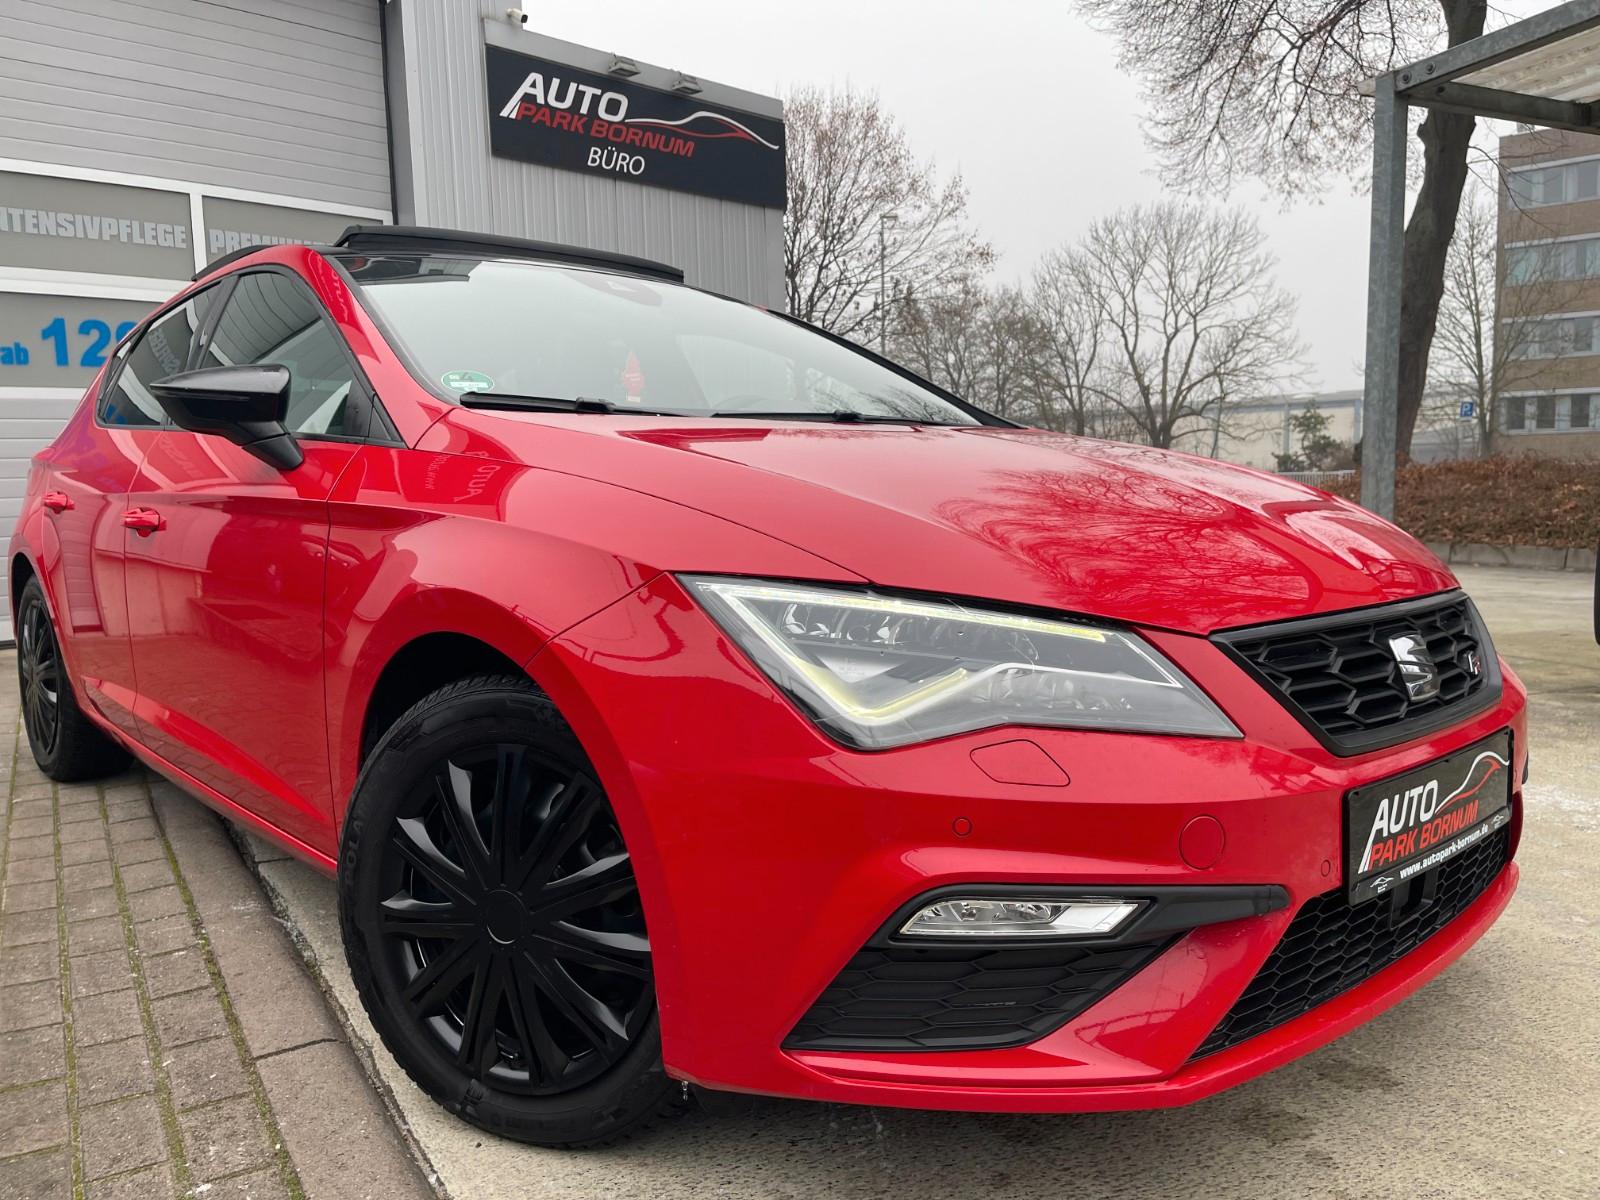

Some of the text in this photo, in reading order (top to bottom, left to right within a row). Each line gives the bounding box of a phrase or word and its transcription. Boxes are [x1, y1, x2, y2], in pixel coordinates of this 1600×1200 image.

[500, 72, 628, 122] AUTO
[515, 102, 695, 157] PARK BORNUM
[587, 146, 645, 175] BÜRO
[0, 341, 29, 366] ab
[1358, 780, 1438, 874] AUTO
[1368, 800, 1479, 871] PARK BORNUM
[1400, 823, 1489, 879] www.autopark-bornum.de
